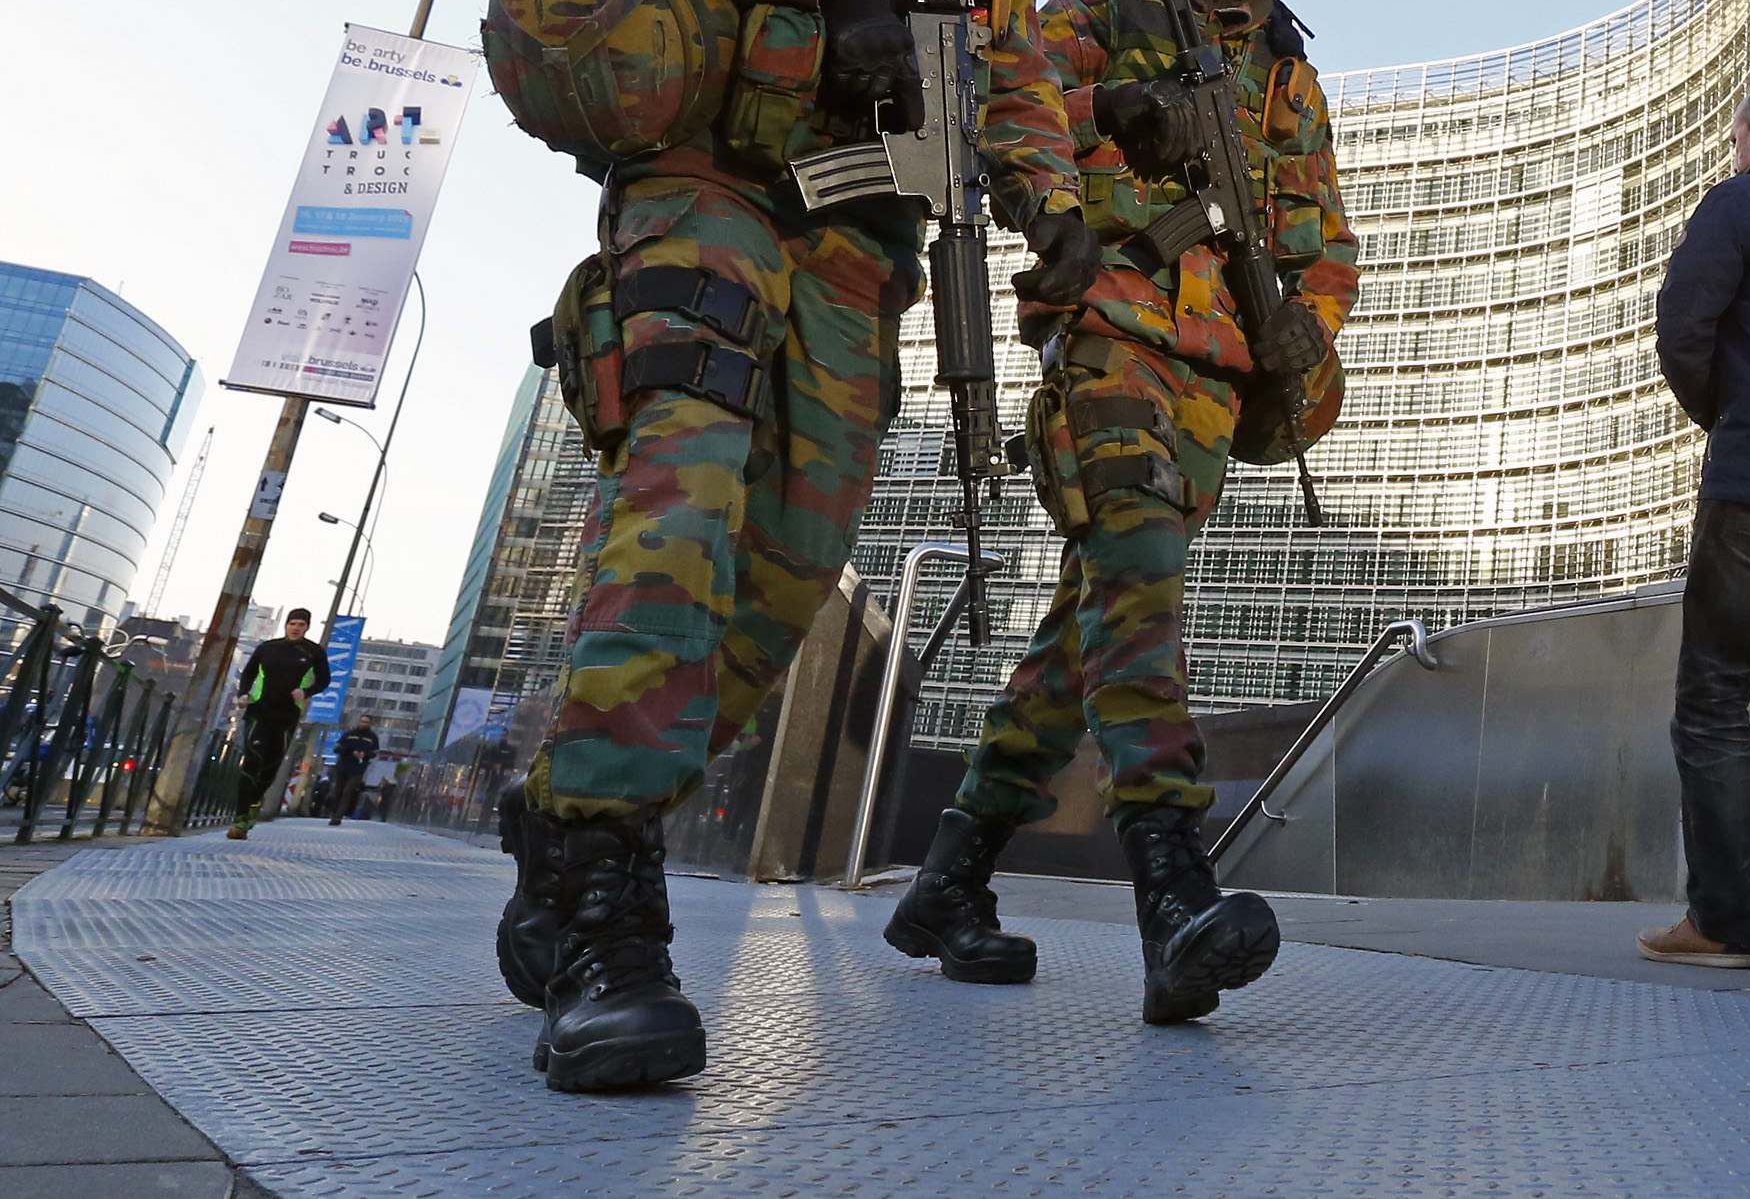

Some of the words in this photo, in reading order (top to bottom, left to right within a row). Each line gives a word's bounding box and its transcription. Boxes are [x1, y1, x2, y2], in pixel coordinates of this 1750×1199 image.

[345, 39, 367, 54] be
[372, 46, 406, 64] arty
[357, 181, 408, 195] DESIGN
